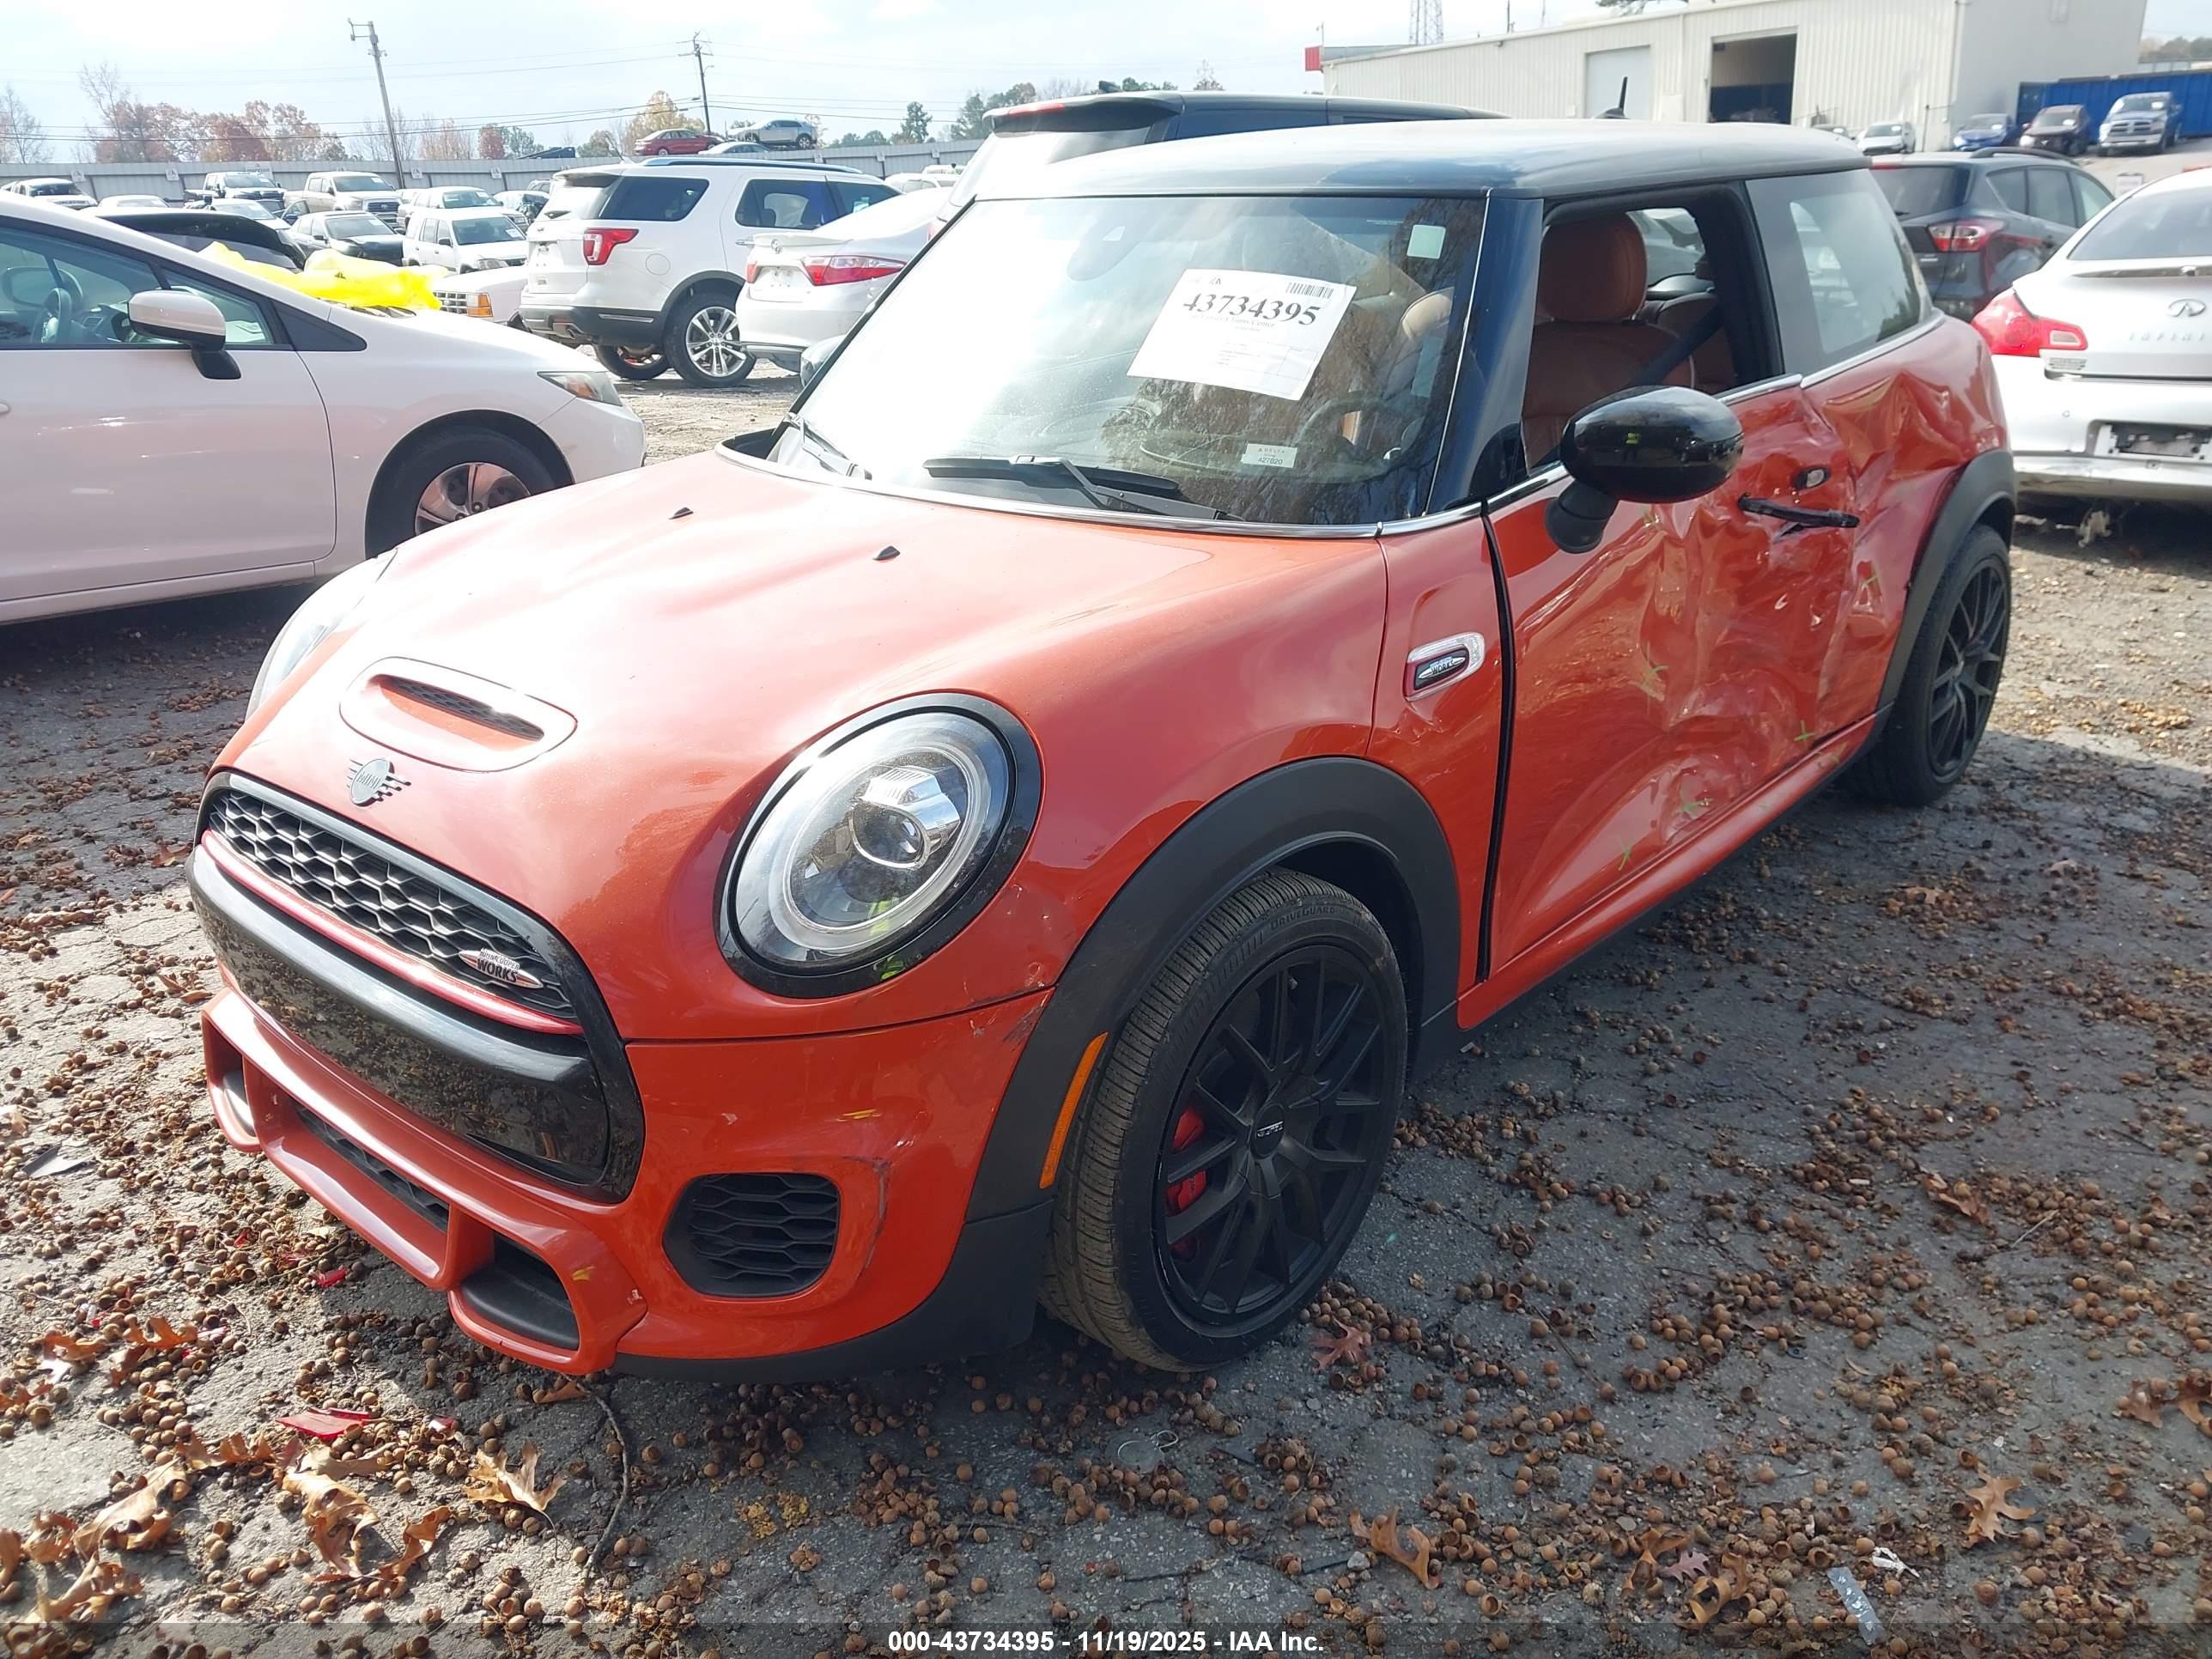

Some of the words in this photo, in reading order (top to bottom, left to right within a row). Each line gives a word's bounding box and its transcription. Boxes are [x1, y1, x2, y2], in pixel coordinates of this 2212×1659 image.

[1182, 292, 1322, 325] 43734395
[356, 771, 382, 790] MINI
[477, 957, 519, 983] WORKS
